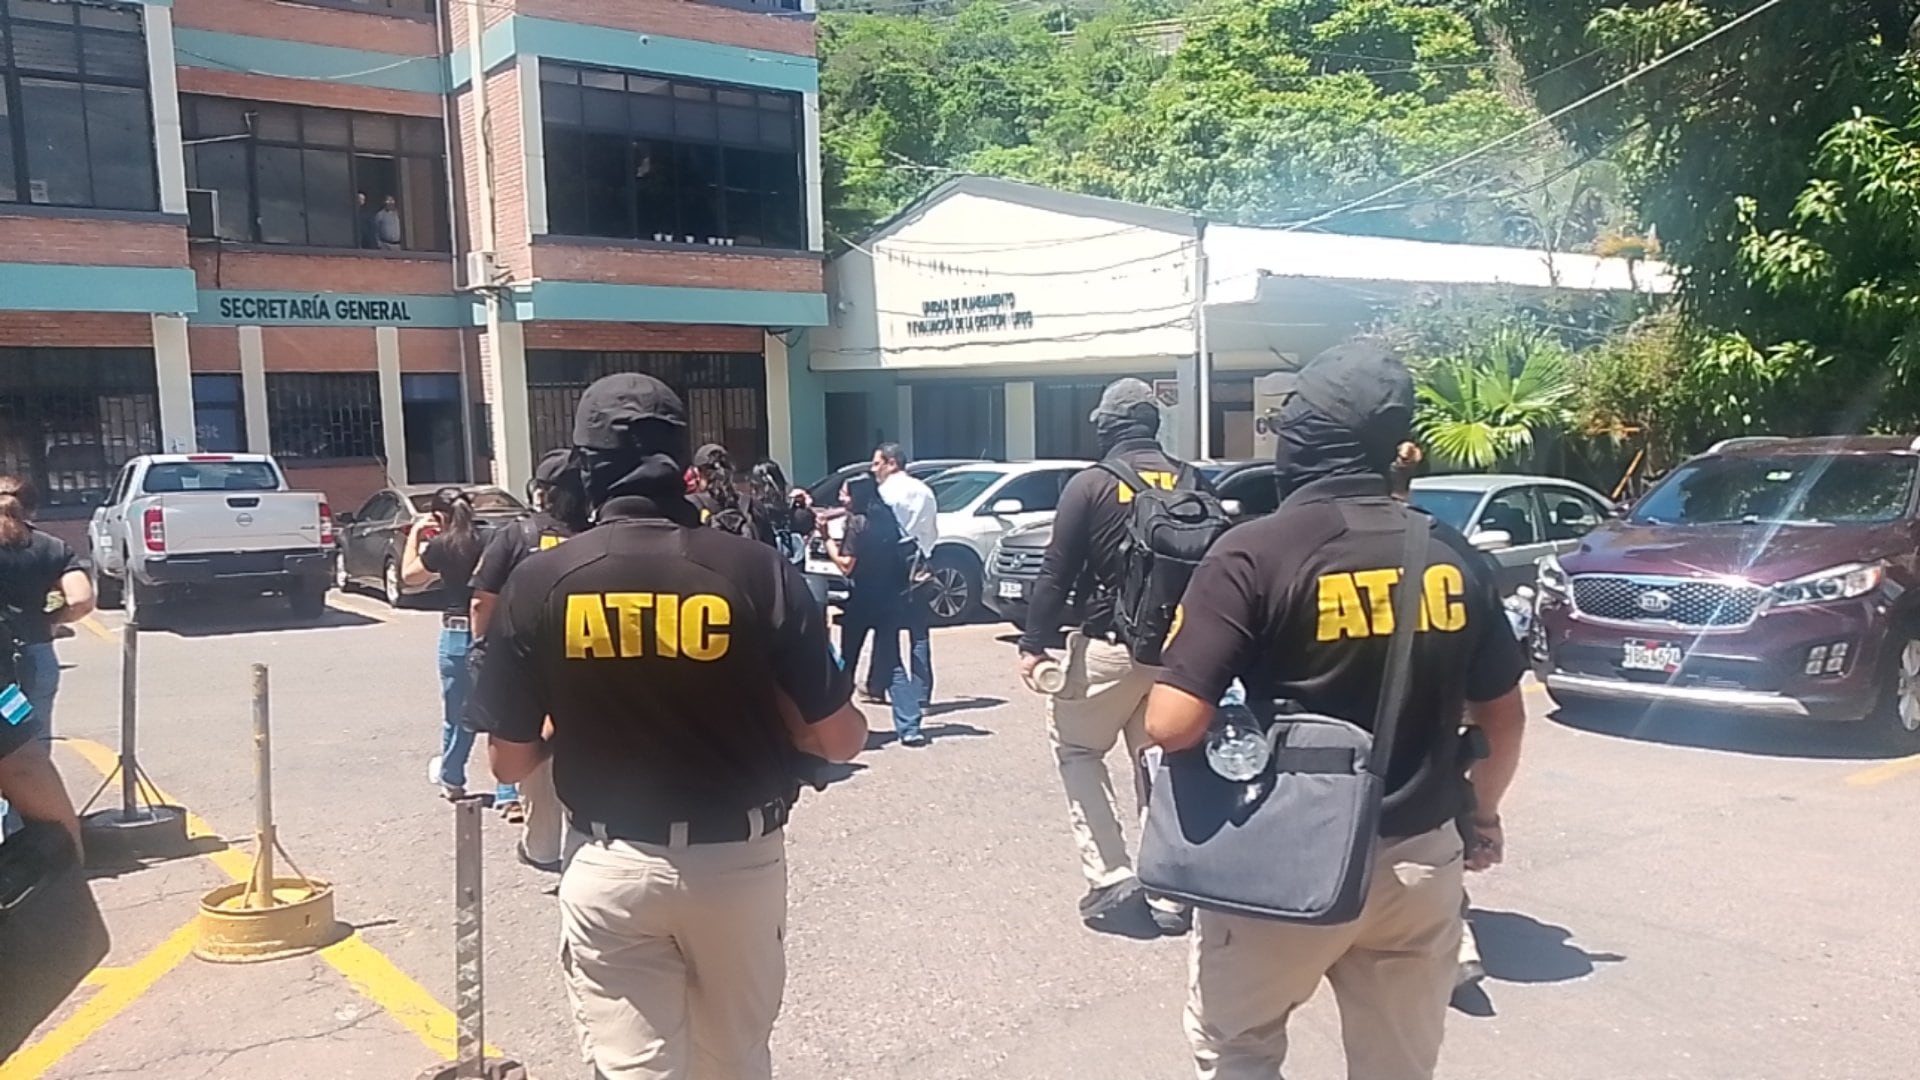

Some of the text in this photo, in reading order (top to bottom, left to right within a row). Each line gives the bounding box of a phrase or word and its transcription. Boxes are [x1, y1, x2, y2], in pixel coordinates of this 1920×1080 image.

[220, 294, 411, 321] SECRETARÍA GENERAL
[565, 592, 731, 661] ATIC
[1316, 563, 1467, 641] ATC
